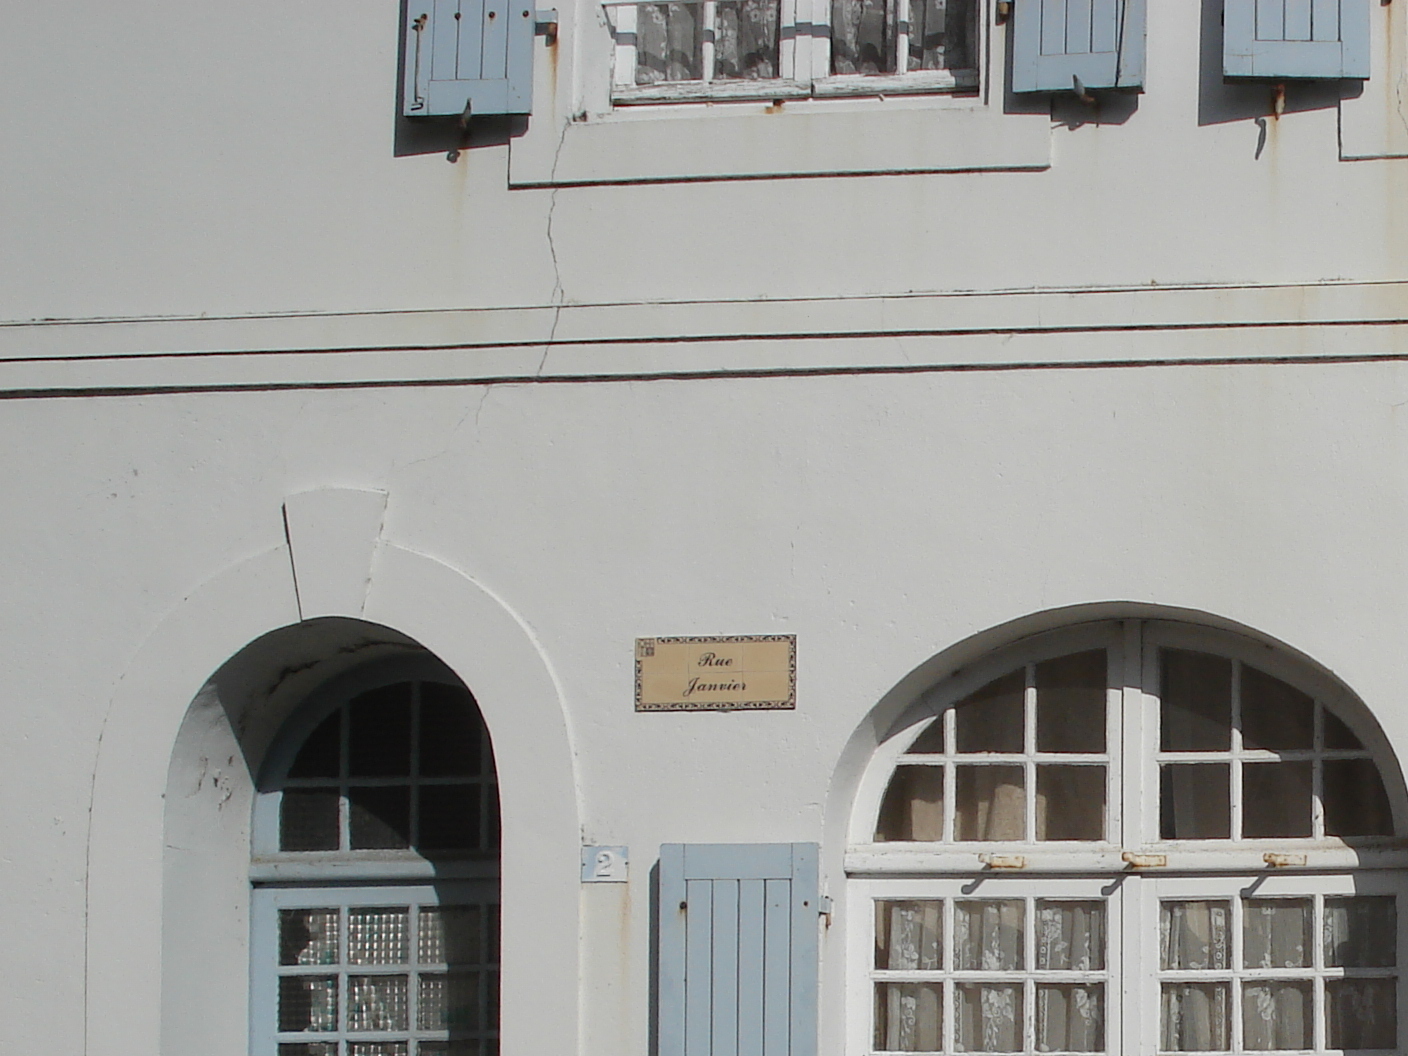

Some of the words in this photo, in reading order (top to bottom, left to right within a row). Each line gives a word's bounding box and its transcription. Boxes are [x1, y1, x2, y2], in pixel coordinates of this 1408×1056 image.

[698, 652, 733, 667] Rue
[682, 677, 747, 697] Janvier
[596, 850, 614, 877] 2
